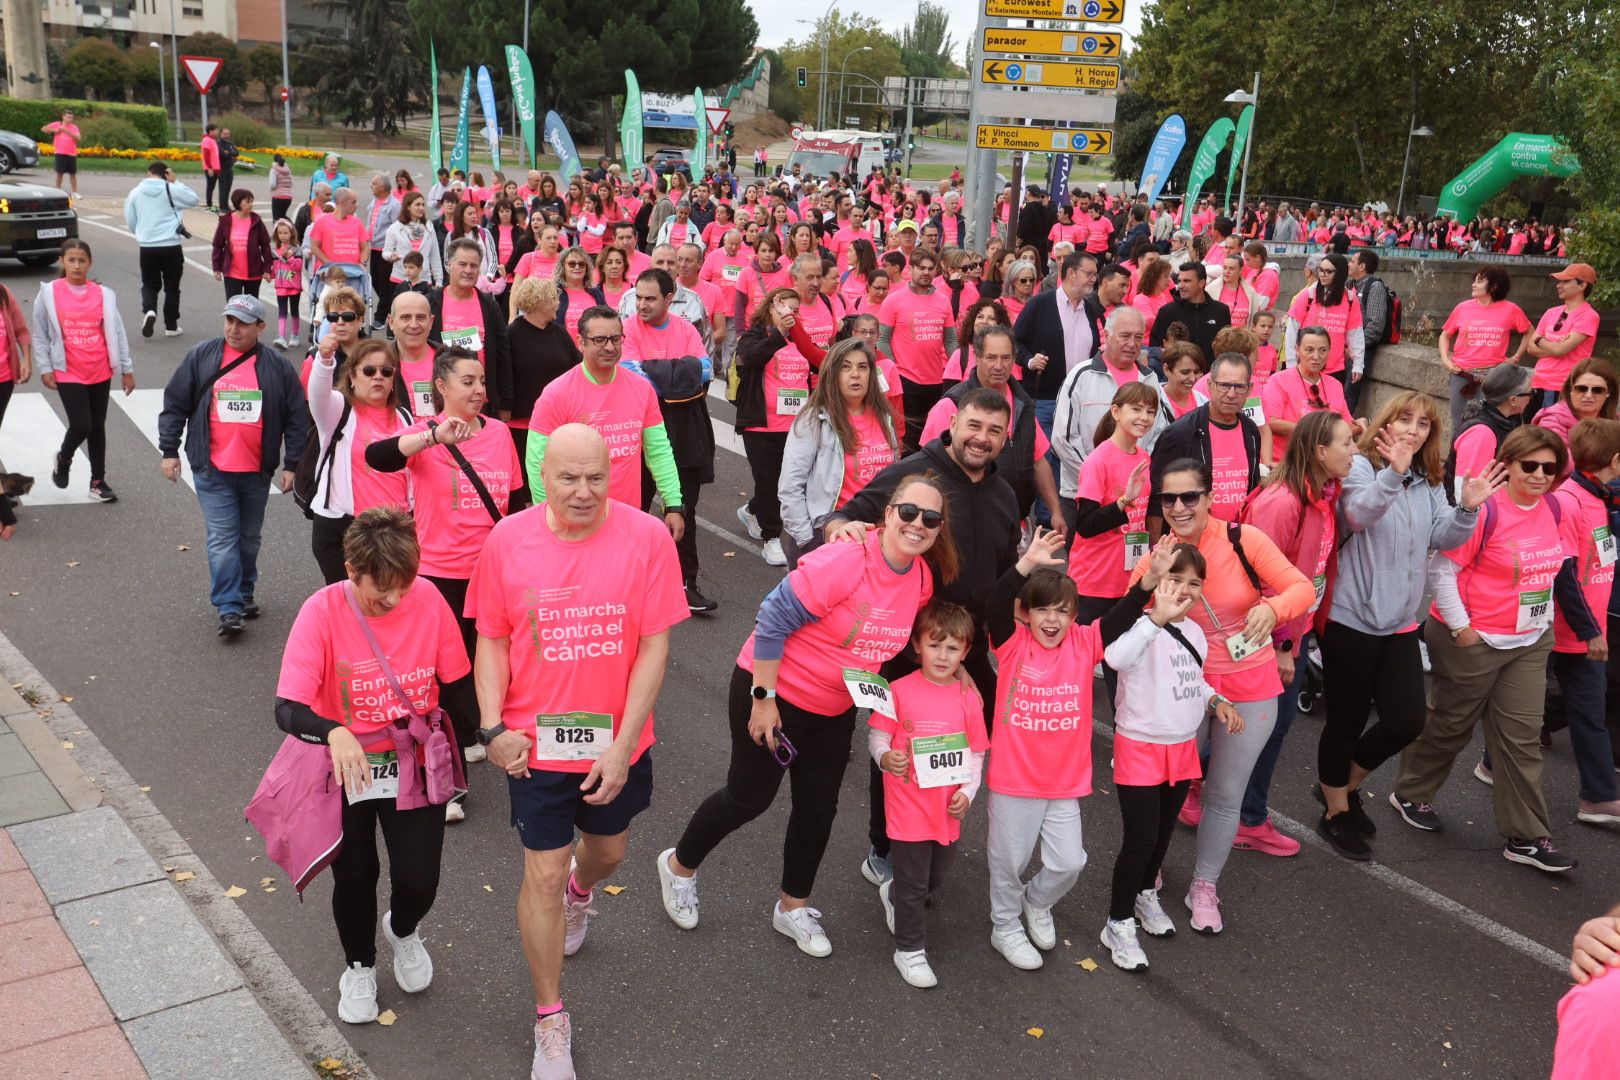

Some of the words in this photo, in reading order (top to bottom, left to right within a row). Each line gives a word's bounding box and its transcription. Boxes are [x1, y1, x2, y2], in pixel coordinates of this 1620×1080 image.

[1032, 9, 1062, 17] Montalvo
[987, 36, 1027, 46] parador
[1075, 68, 1083, 76] H.
[1088, 68, 1116, 77] Horus
[1076, 76, 1084, 85] H.
[1089, 77, 1115, 87] Regio
[979, 128, 988, 136] H.
[992, 129, 1019, 138] Vincci
[979, 137, 988, 145] H.
[991, 138, 1000, 146] P.
[1003, 138, 1040, 148] Romano
[1513, 141, 1525, 150] En
[1511, 152, 1537, 161] contra
[227, 401, 252, 412] 4523
[784, 397, 801, 407] 8363
[604, 419, 643, 432] marcha
[604, 433, 631, 444] ntra
[610, 444, 639, 458] ncer
[1132, 545, 1142, 557] 816
[1519, 550, 1535, 562] En
[538, 607, 560, 621] En
[564, 602, 626, 619] marcha
[541, 621, 603, 641] contra
[605, 618, 623, 635] el
[862, 621, 878, 635] En
[880, 624, 912, 638] march
[543, 639, 623, 662] cáncer
[1169, 654, 1197, 669] WHA
[1177, 670, 1196, 686] YOU
[351, 679, 373, 692] En
[353, 687, 414, 707] conta
[417, 678, 432, 696] el
[858, 682, 888, 702] 6408
[1016, 680, 1028, 694] En
[1031, 682, 1080, 697] marcha
[1172, 685, 1202, 702] LOVE
[355, 692, 429, 723] cáncer
[1014, 697, 1063, 714] contra
[1064, 696, 1080, 712] el
[1010, 712, 1081, 732] cáncer
[555, 727, 595, 743] 8125
[929, 751, 963, 770] 6407
